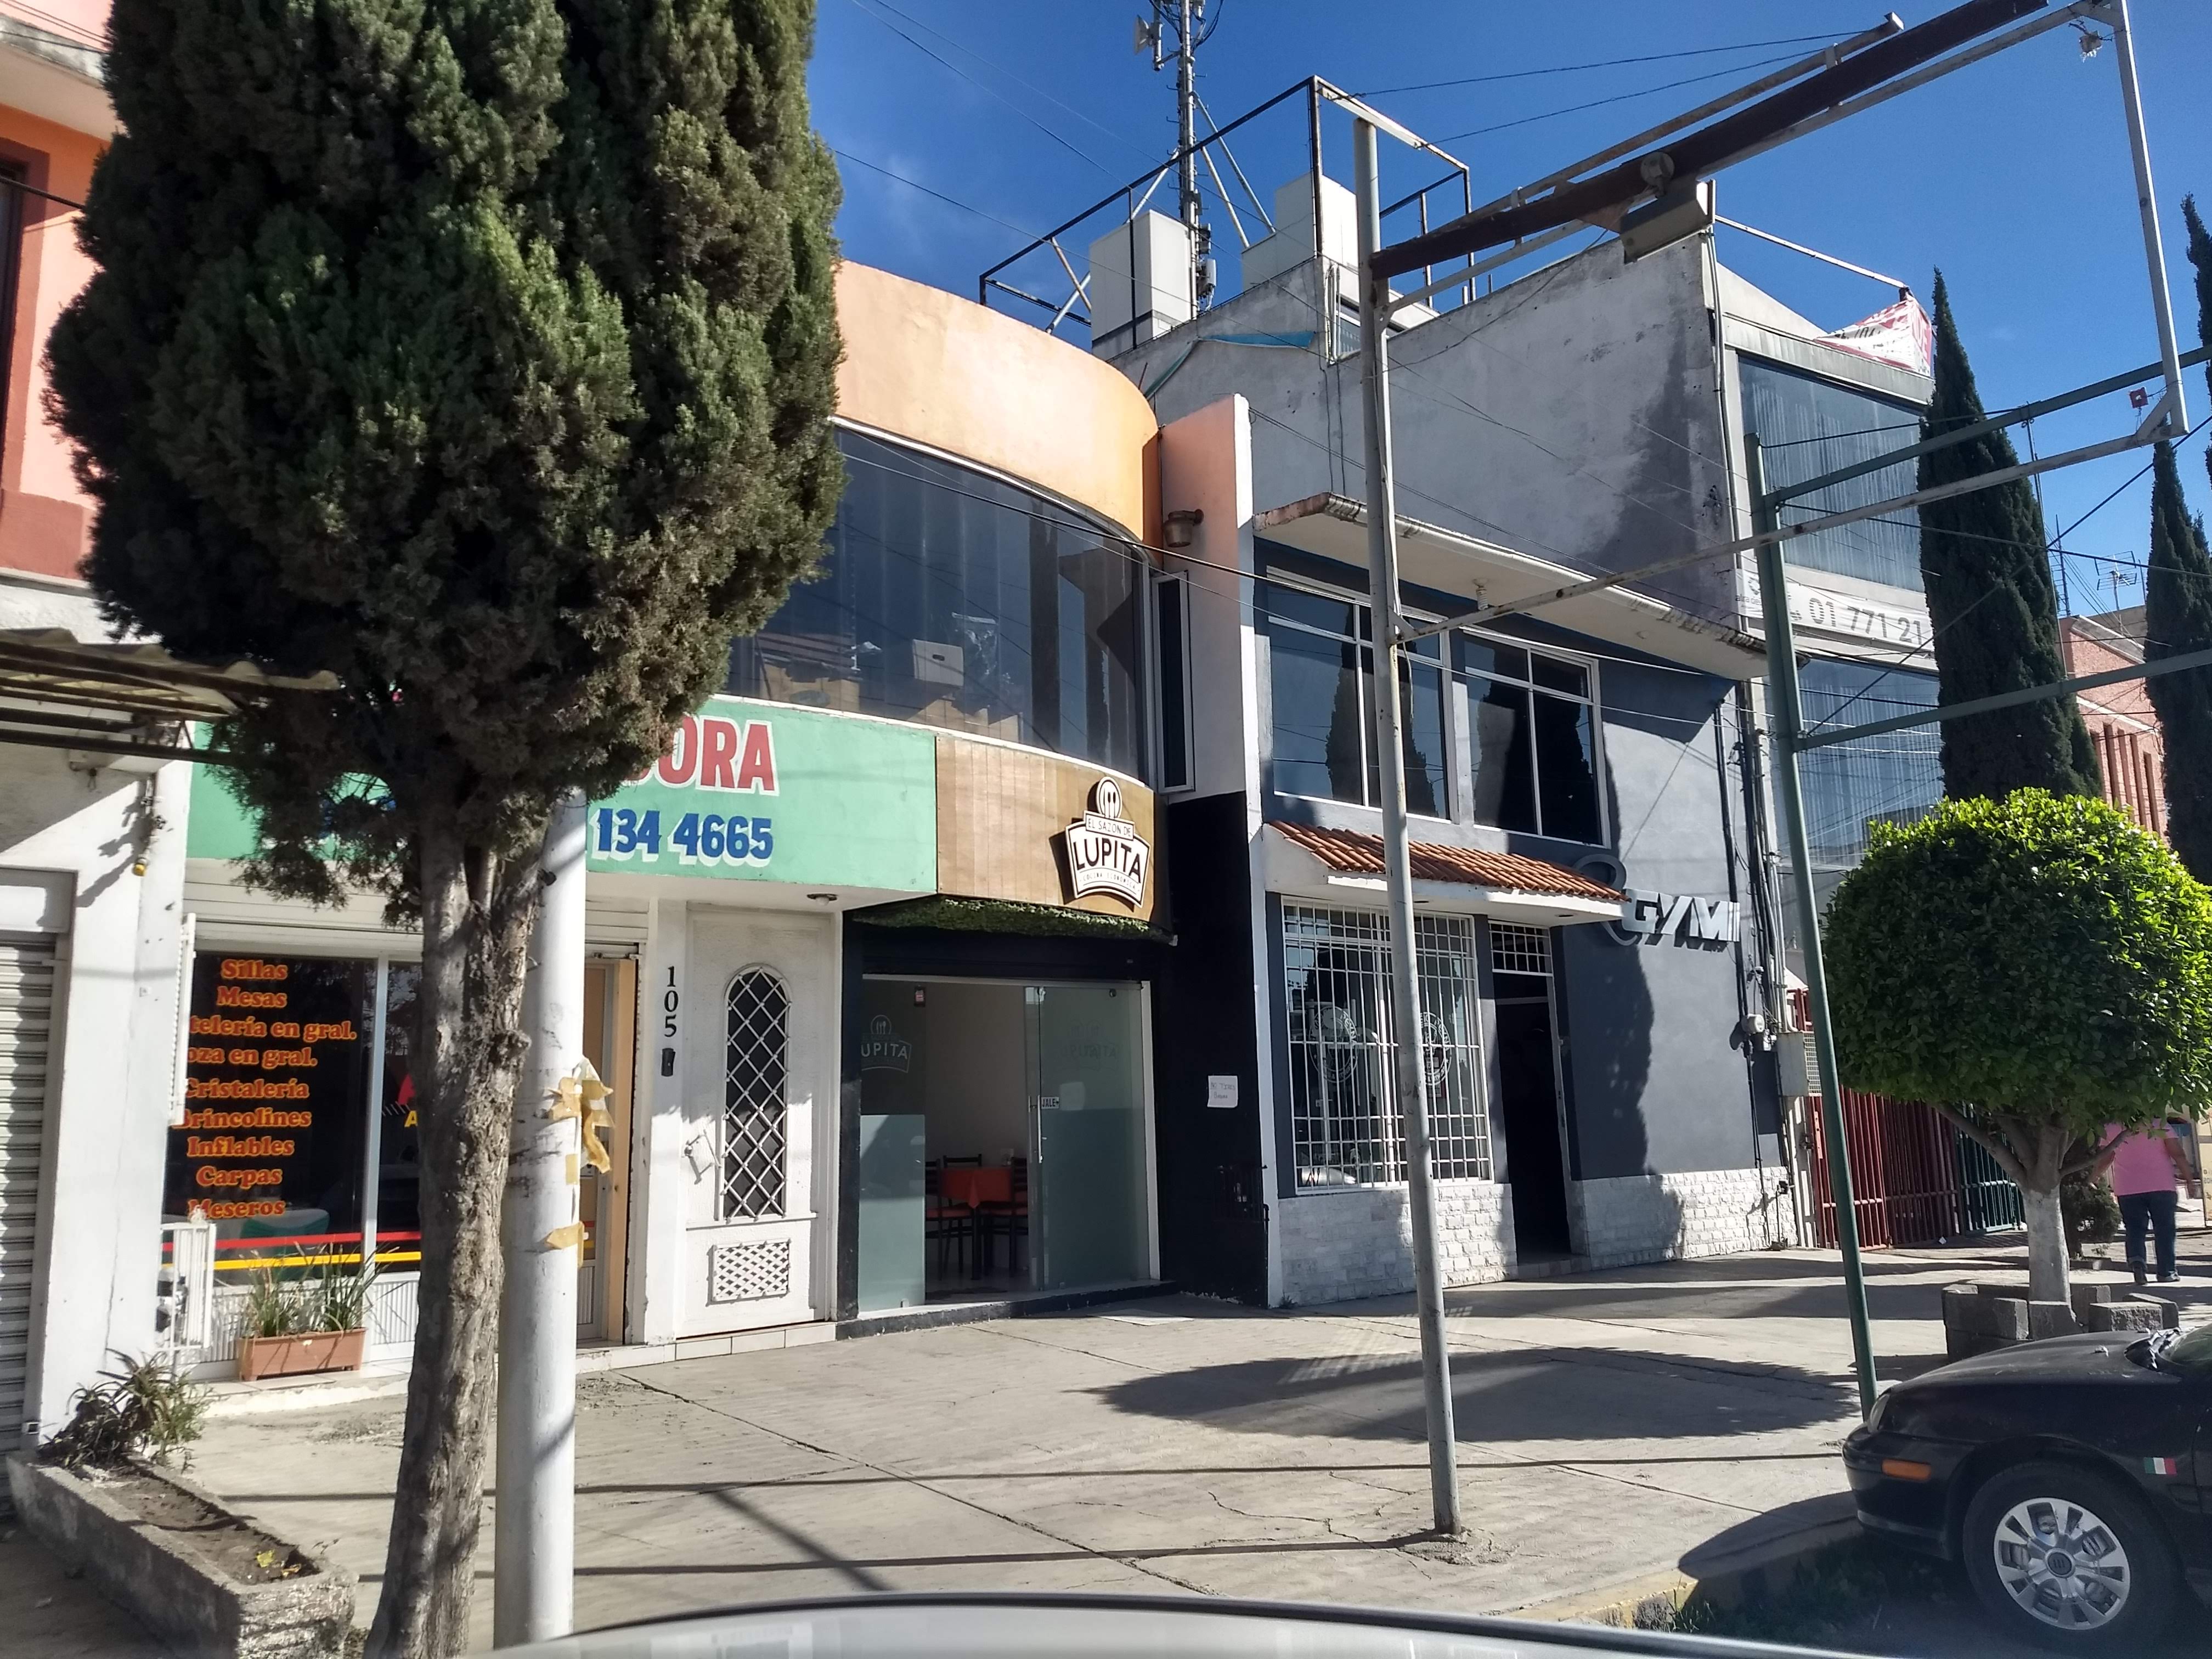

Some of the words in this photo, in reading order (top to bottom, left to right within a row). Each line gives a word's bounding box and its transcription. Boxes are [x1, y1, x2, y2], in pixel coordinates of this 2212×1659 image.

[1809, 597, 1836, 627] 01
[1847, 605, 1887, 638] 771
[1898, 617, 1922, 645] 21
[621, 713, 777, 793] ORA
[594, 808, 662, 857] 134
[670, 812, 774, 863] 4665
[1088, 818, 1096, 828] EL
[1124, 826, 1131, 837] DE
[1073, 837, 1141, 884] LUPITA
[1622, 888, 1740, 942] GYM
[221, 959, 288, 980] Sillas
[217, 986, 288, 1008] Mesas
[664, 966, 679, 1037] 105
[270, 1022, 300, 1038] en
[303, 1020, 357, 1042] gral.
[228, 1048, 259, 1064] en
[261, 1047, 318, 1069] gral.
[1042, 1098, 1056, 1107] JALE
[187, 1136, 295, 1157] Inflables
[196, 1165, 283, 1189] Carpas
